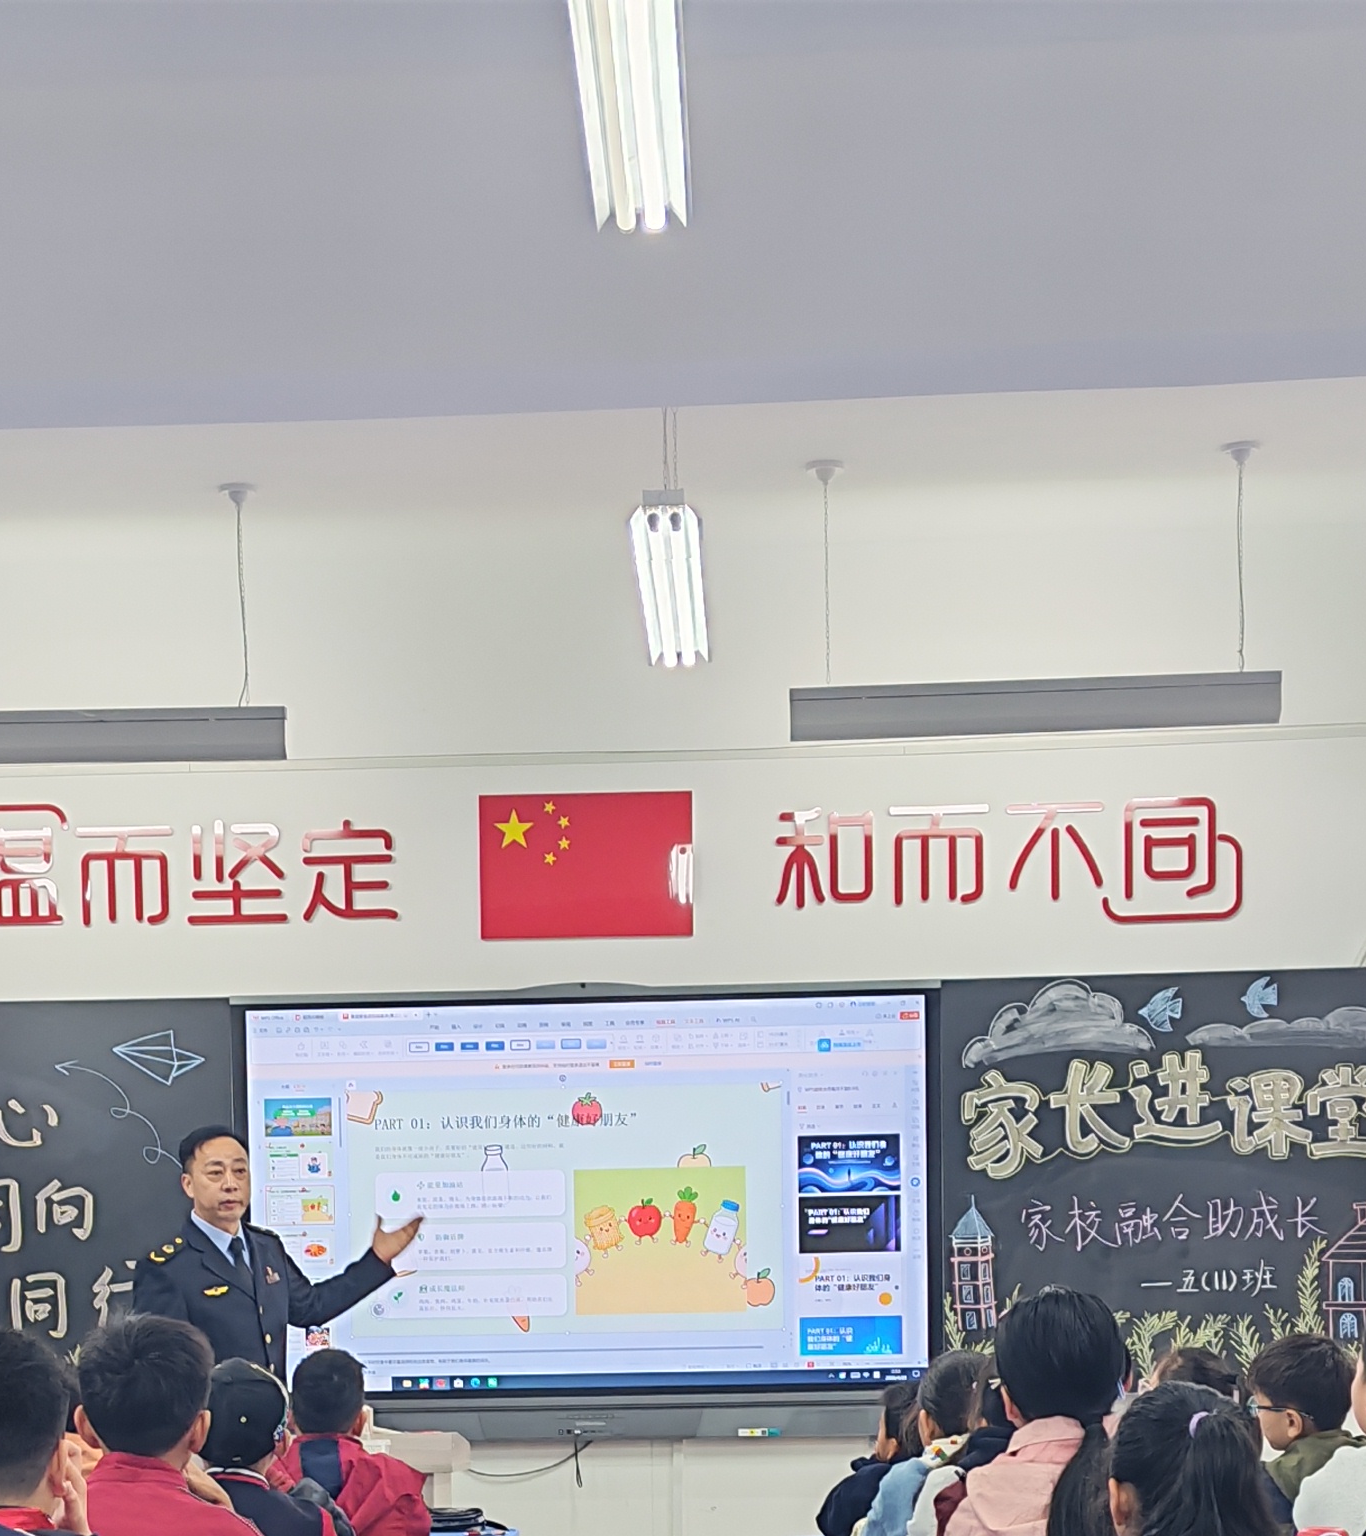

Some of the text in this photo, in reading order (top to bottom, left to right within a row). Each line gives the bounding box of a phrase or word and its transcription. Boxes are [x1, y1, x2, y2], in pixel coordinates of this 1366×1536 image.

[775, 796, 1218, 910] 和而不同
[374, 1117, 404, 1130] PART
[1019, 1191, 1328, 1252] 家校融合助成长
